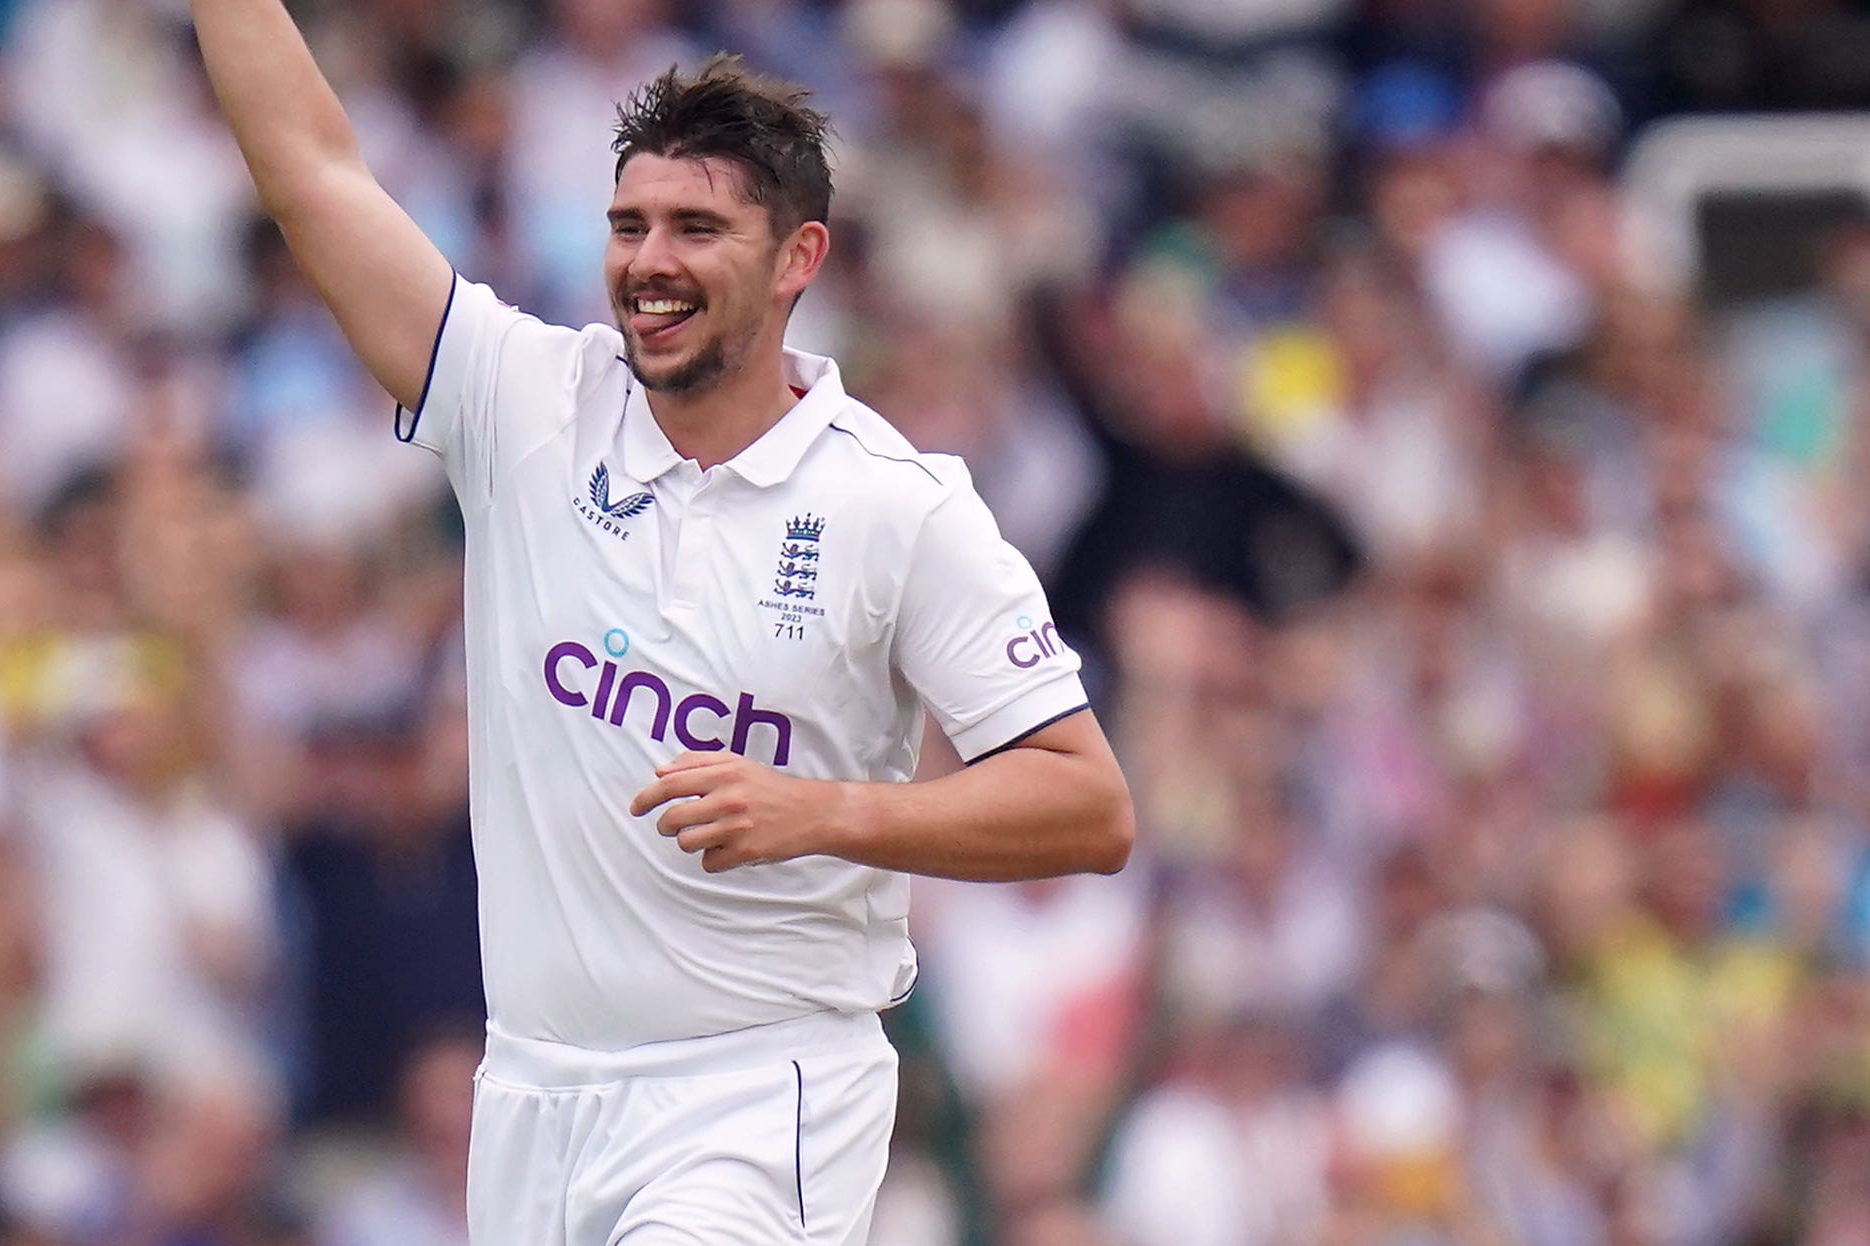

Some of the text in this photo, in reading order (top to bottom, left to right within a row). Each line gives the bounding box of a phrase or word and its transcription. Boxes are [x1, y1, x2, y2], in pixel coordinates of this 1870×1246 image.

[572, 496, 631, 541] CASTORE
[758, 599, 825, 617] ASHES SERIES
[781, 611, 803, 623] 2023
[775, 623, 805, 641] 711
[543, 627, 792, 767] cinch
